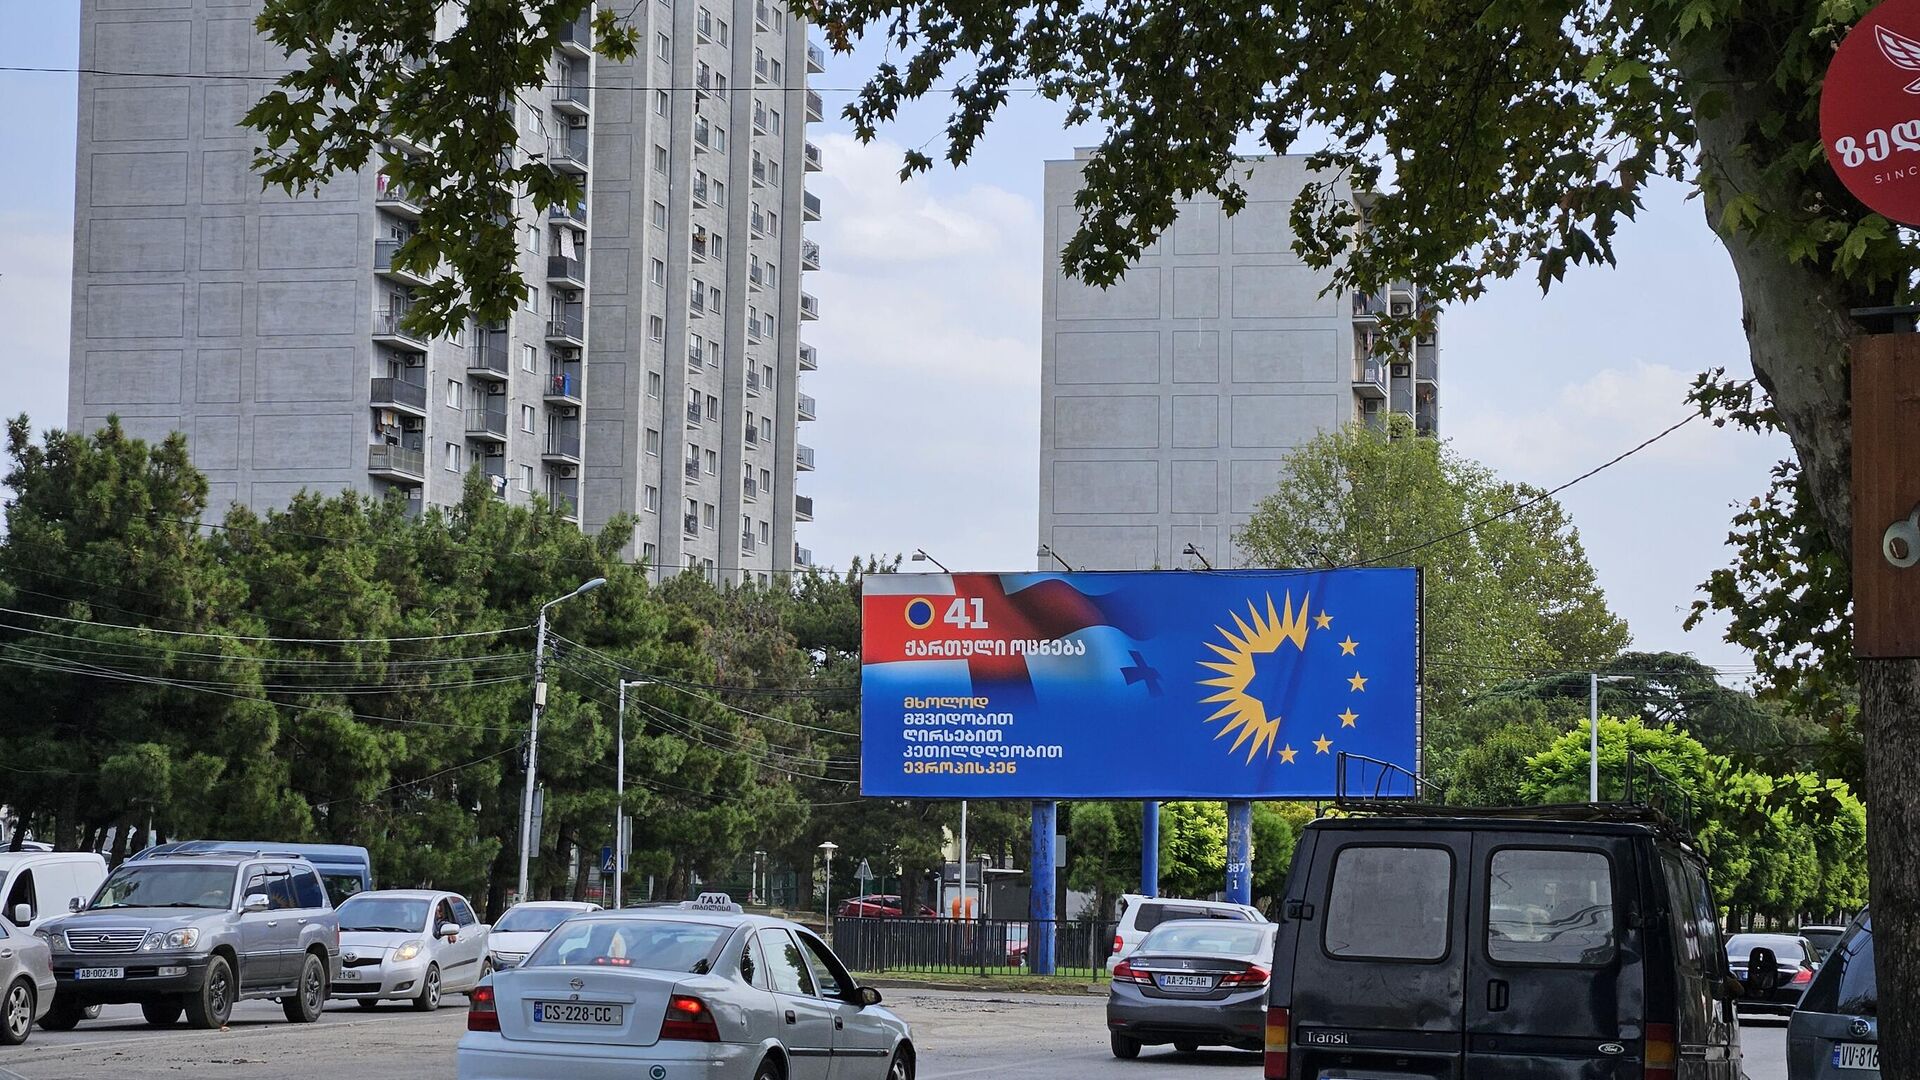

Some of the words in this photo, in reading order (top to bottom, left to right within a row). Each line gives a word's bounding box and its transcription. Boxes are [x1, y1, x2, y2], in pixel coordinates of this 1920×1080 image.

[943, 597, 989, 630] 41
[904, 639, 1006, 656] ქართული
[1010, 639, 1086, 656] ოცნება
[903, 696, 989, 709] მხოლოდ
[903, 713, 1014, 726] მშვიდობით
[903, 729, 1003, 742] ღირსებით
[903, 745, 1063, 758] კეთილდღეობით
[903, 761, 1017, 774] ევროპისკენ
[1227, 863, 1246, 873] 387
[701, 895, 726, 905] TAXI
[1165, 974, 1207, 986] AA-215-AH
[544, 1004, 612, 1022] CS-228-CC
